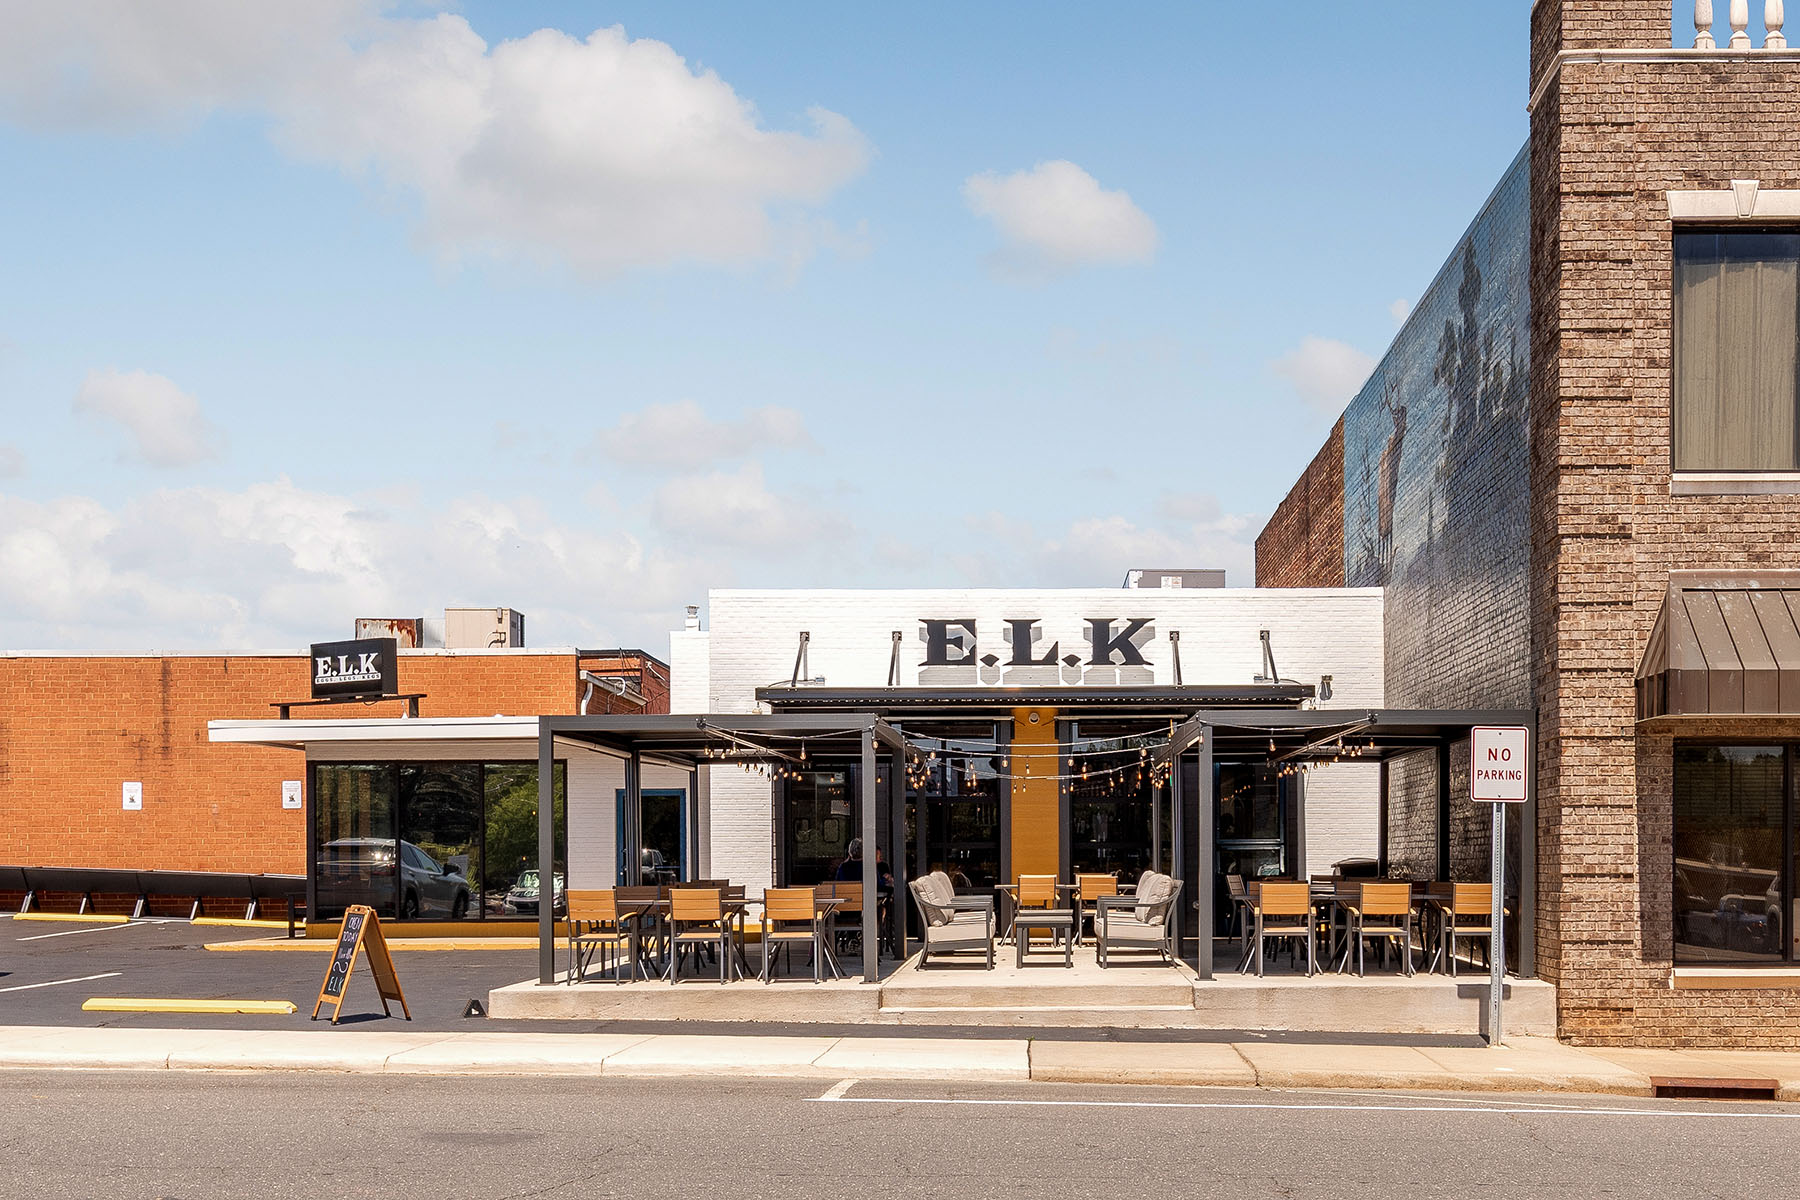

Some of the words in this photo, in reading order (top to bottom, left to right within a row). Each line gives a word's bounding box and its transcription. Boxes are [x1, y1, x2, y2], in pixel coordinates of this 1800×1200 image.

[918, 618, 1155, 667] E.L.K
[315, 652, 378, 677] E.L.K
[1487, 748, 1511, 761] NO
[1477, 769, 1522, 780] PARKING
[328, 976, 344, 992] ELK
